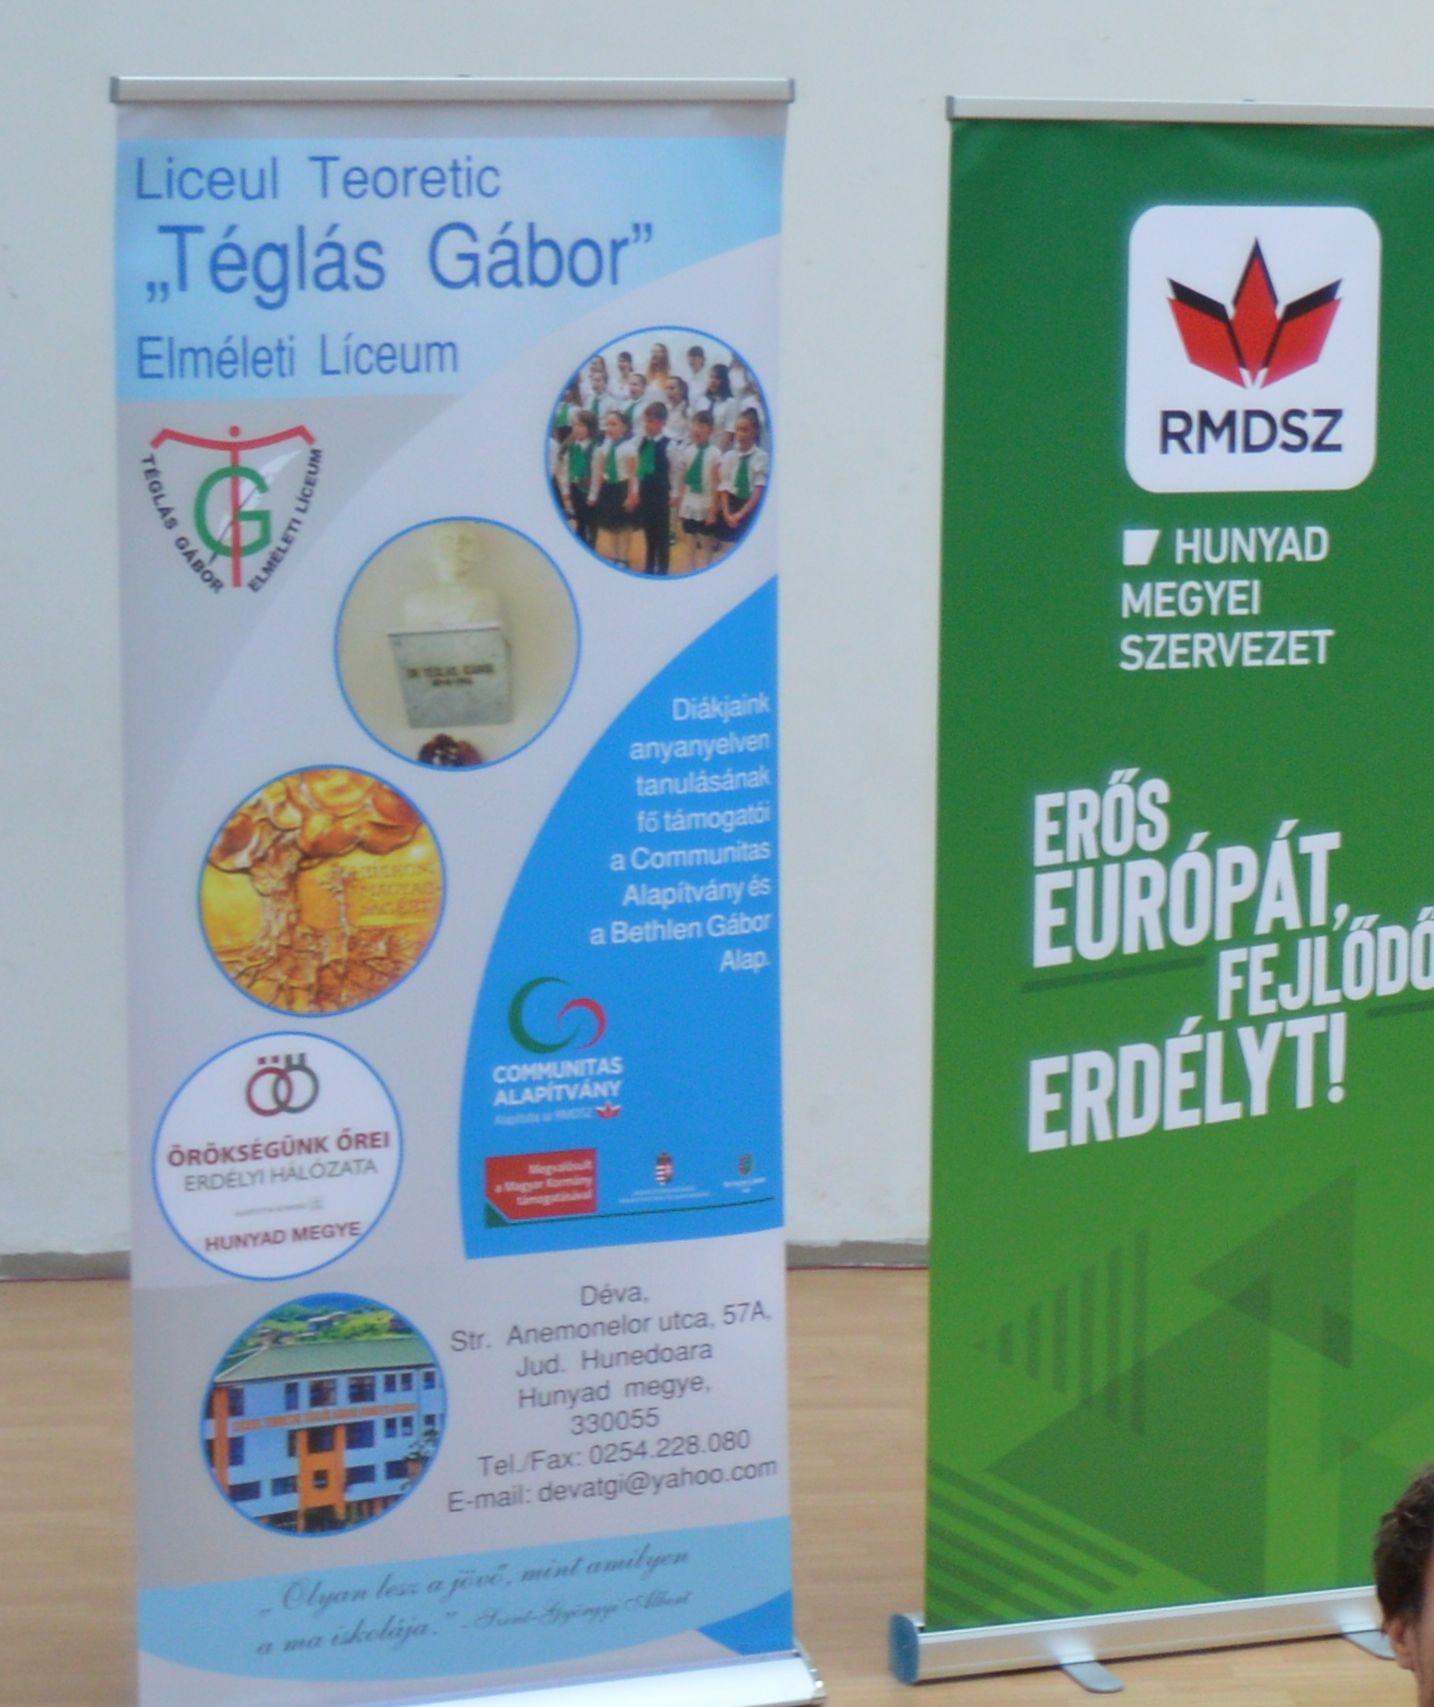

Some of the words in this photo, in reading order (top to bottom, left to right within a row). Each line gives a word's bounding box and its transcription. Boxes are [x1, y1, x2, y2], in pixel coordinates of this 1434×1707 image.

[135, 156, 280, 200] Liceul
[309, 154, 502, 199] Teoretic
[137, 334, 297, 380] Elméleti
[319, 333, 460, 375] Líceum
[1160, 408, 1344, 455] RMDSZ
[1175, 526, 1329, 564] HUNYAD
[174, 535, 224, 594] GÁBOR
[1121, 580, 1260, 618] MEGYEI
[1119, 629, 1334, 670] SZERVEZET
[671, 692, 770, 724] Diákjaink
[629, 731, 770, 764] anyanyelven
[635, 765, 771, 797] tanulásának
[636, 810, 660, 833] fő
[1034, 767, 1171, 867] ERŐS
[609, 852, 626, 871] a
[630, 840, 771, 871] Communitas
[622, 880, 745, 910] Alapítvány
[748, 875, 771, 896] és
[1033, 819, 1350, 969] EURÓPÁT,
[590, 927, 605, 945] a
[611, 919, 702, 945] Bethlen
[707, 911, 772, 938] Gábor
[492, 1056, 624, 1084] COMMUNITAS
[1028, 1012, 1347, 1152] ERDÉLYT!
[493, 1079, 623, 1106] ALAPÍTVÁNY
[184, 1168, 265, 1192] ERDÉLYI
[269, 1157, 378, 1184] HÁLÓZATA
[204, 1228, 287, 1252] HUNYAD
[291, 1221, 361, 1242] MEGYE
[450, 1329, 492, 1352] Str.
[506, 1313, 652, 1346] Anemonelor
[515, 1356, 566, 1378] Jud.
[581, 1342, 714, 1372] Hunedoara
[518, 1380, 610, 1409] Hunyad
[570, 1407, 660, 1435] 330055
[447, 1487, 531, 1513] E-mail:
[538, 1459, 778, 1503] devatgi@yahoo.com
[426, 1579, 444, 1593] a
[520, 1556, 583, 1582] mint
[586, 1543, 688, 1581] amilyen
[257, 1642, 272, 1655] a
[283, 1636, 322, 1654] ma
